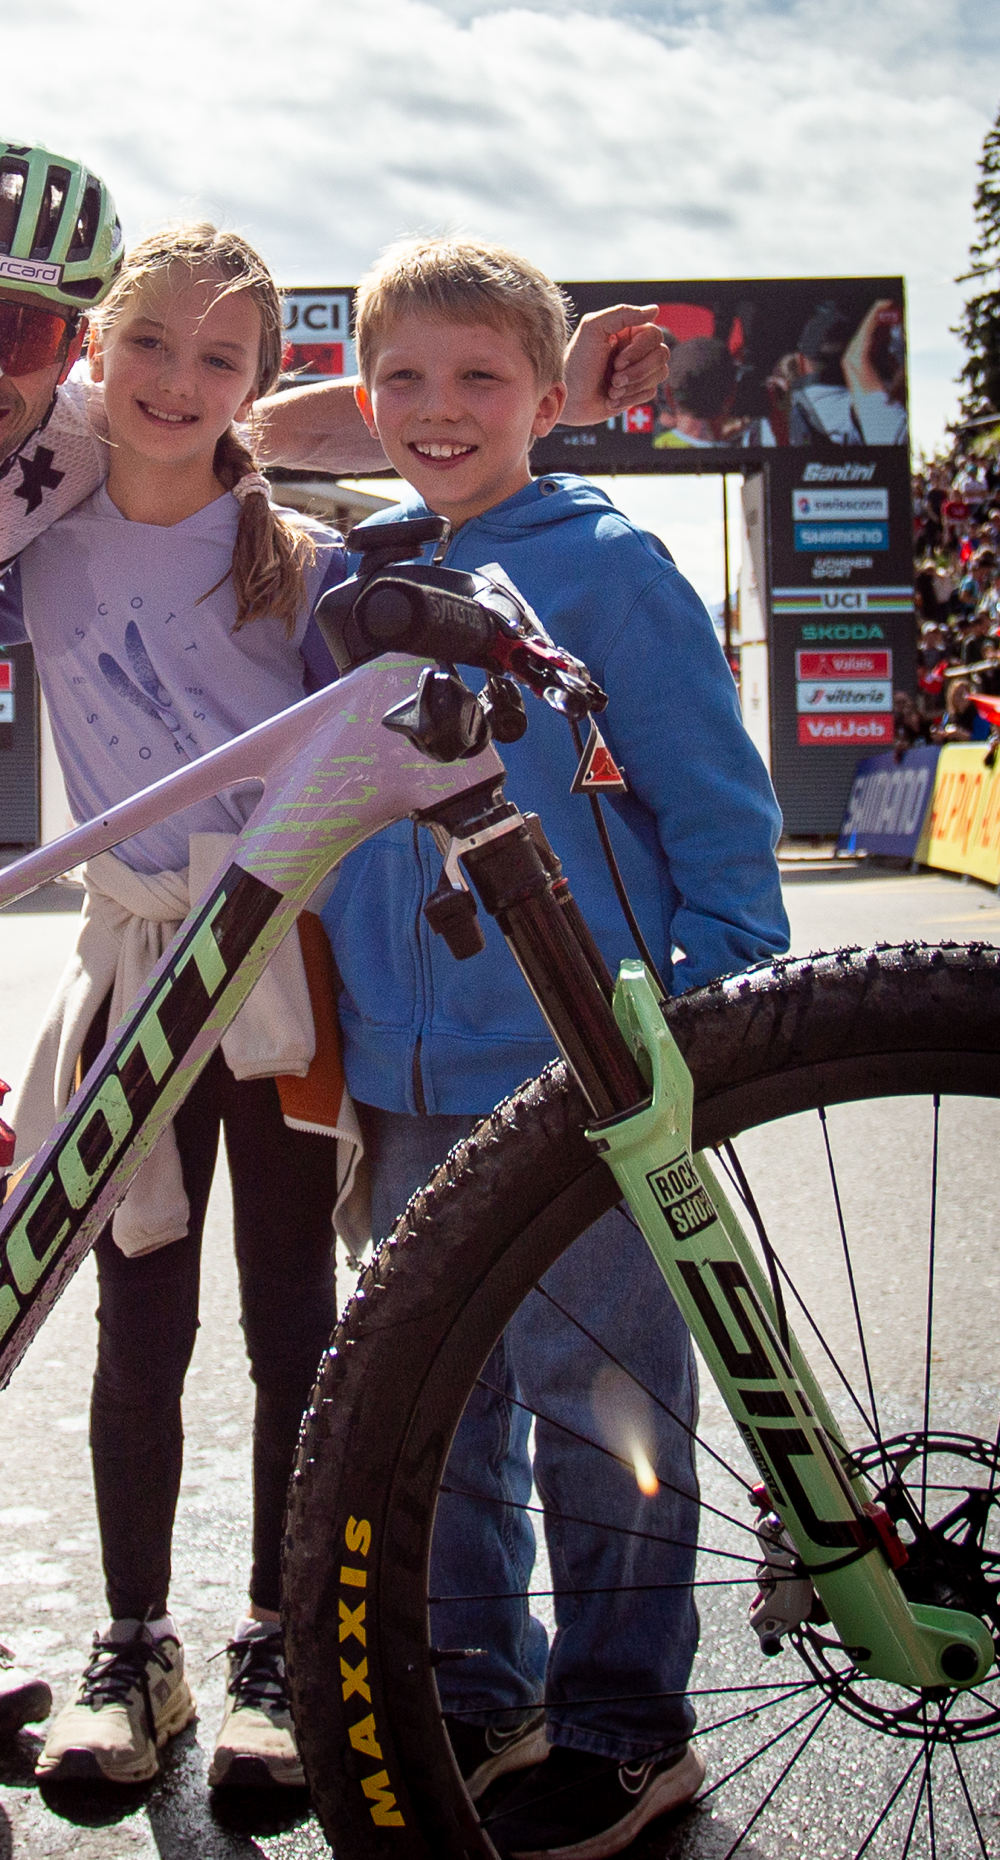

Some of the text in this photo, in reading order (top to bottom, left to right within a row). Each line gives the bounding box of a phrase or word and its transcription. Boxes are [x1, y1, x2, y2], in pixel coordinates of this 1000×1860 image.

[815, 500, 883, 511] swisscom
[801, 528, 883, 544] SHIMANO
[823, 593, 863, 609] UCI
[826, 690, 885, 704] vittoria
[806, 720, 885, 737] ValJob
[655, 1159, 699, 1202] ROCK
[338, 1515, 406, 1826] MAXXIS
